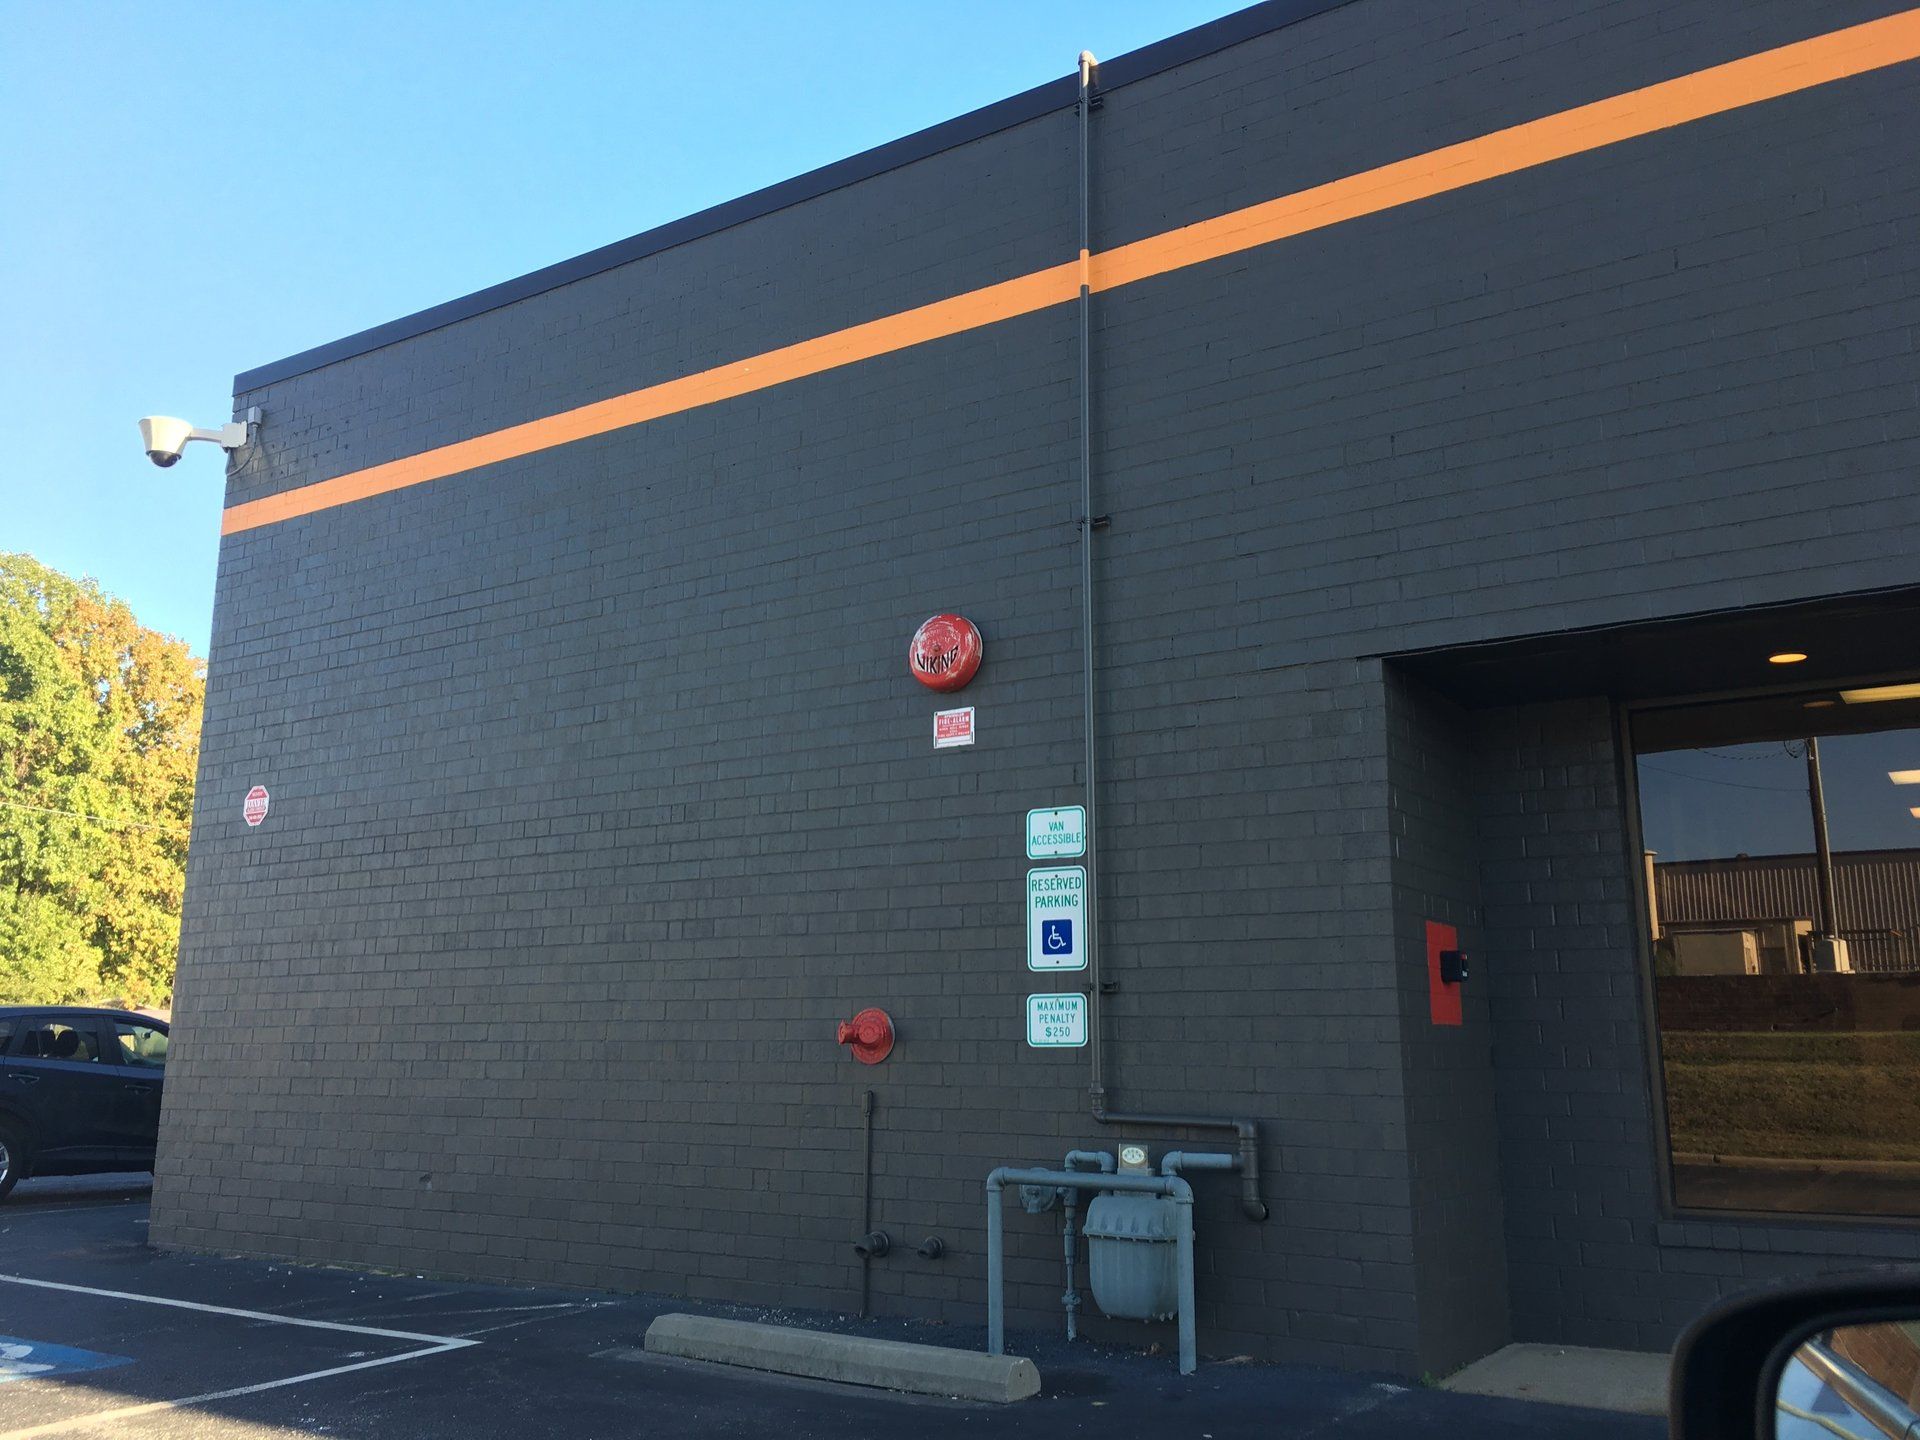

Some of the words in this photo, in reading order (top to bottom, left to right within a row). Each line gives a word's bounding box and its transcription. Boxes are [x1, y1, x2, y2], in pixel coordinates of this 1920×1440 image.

[916, 644, 959, 675] VIKING
[1048, 820, 1064, 832] VAN
[1031, 831, 1082, 846] ACCESSIBLE
[1031, 876, 1082, 892] RESERVED
[1035, 893, 1079, 909] PARKING
[1037, 1000, 1078, 1011] MAXIMUM
[1038, 1013, 1076, 1024] PENALTY
[1045, 1026, 1071, 1038] $250
